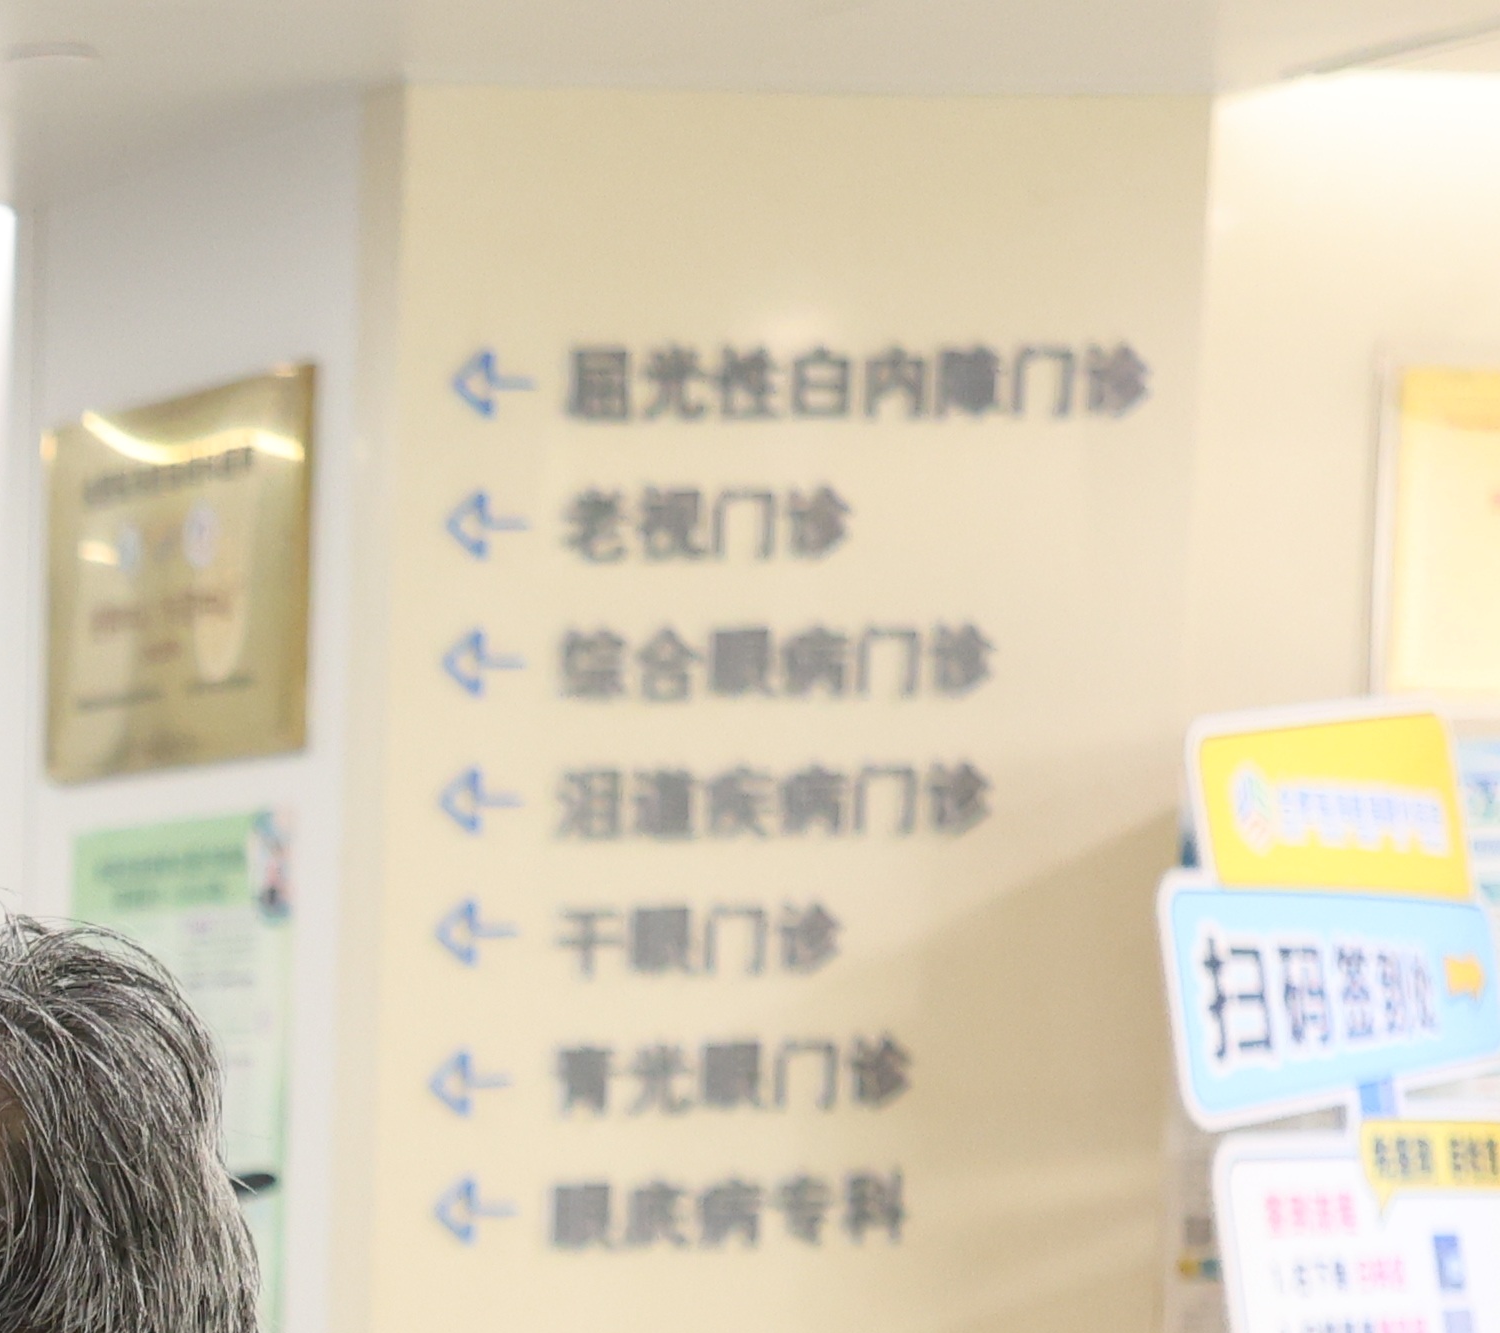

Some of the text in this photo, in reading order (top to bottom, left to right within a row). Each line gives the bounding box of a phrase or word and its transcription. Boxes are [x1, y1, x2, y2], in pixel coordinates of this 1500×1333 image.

[564, 484, 851, 561] 老视门诊
[560, 623, 996, 698] 综合眼病门诊
[556, 761, 993, 840] 泪道疾病门诊
[555, 901, 841, 979] 干眼门诊
[554, 1030, 911, 1118] 青光眼门诊
